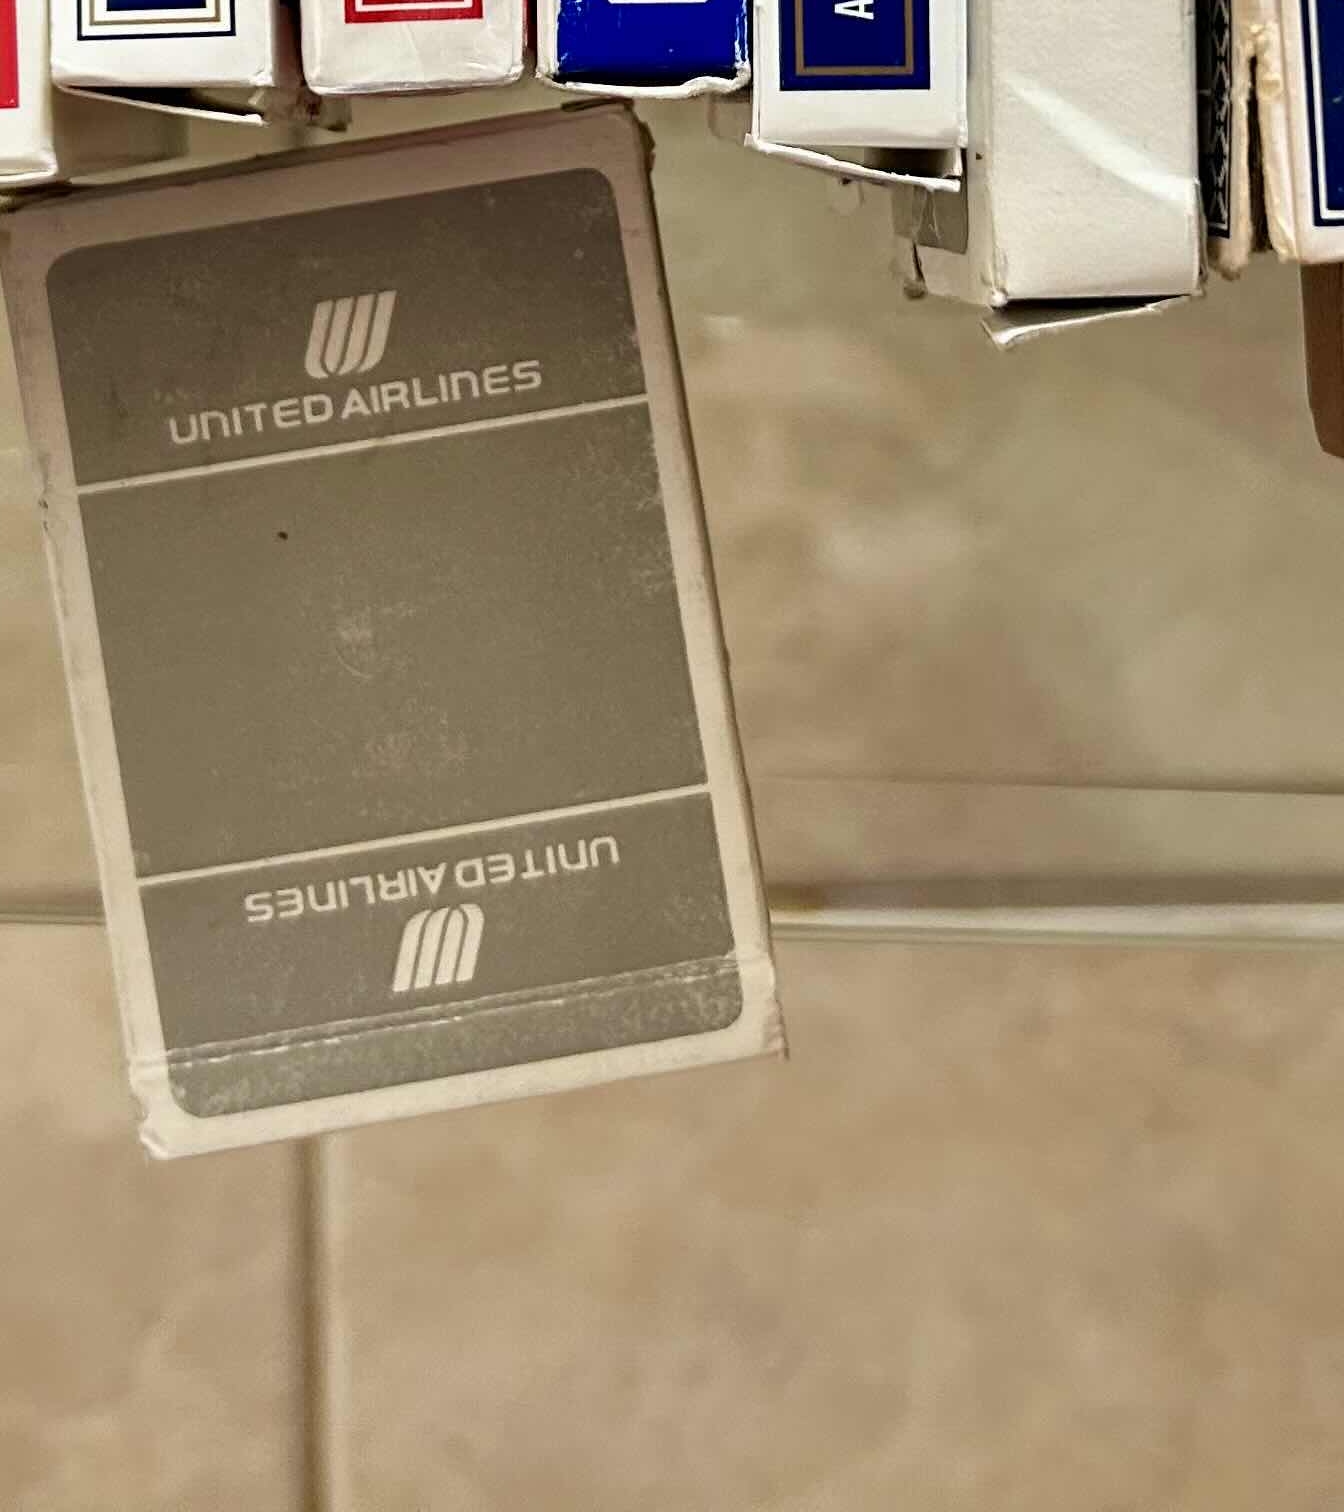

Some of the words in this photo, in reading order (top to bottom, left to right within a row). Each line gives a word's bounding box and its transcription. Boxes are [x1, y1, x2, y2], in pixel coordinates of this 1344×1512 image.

[168, 392, 334, 445] UNITED
[341, 358, 542, 421] AIRLINES
[243, 861, 447, 923] AIRLINES
[455, 835, 621, 889] UNITED
